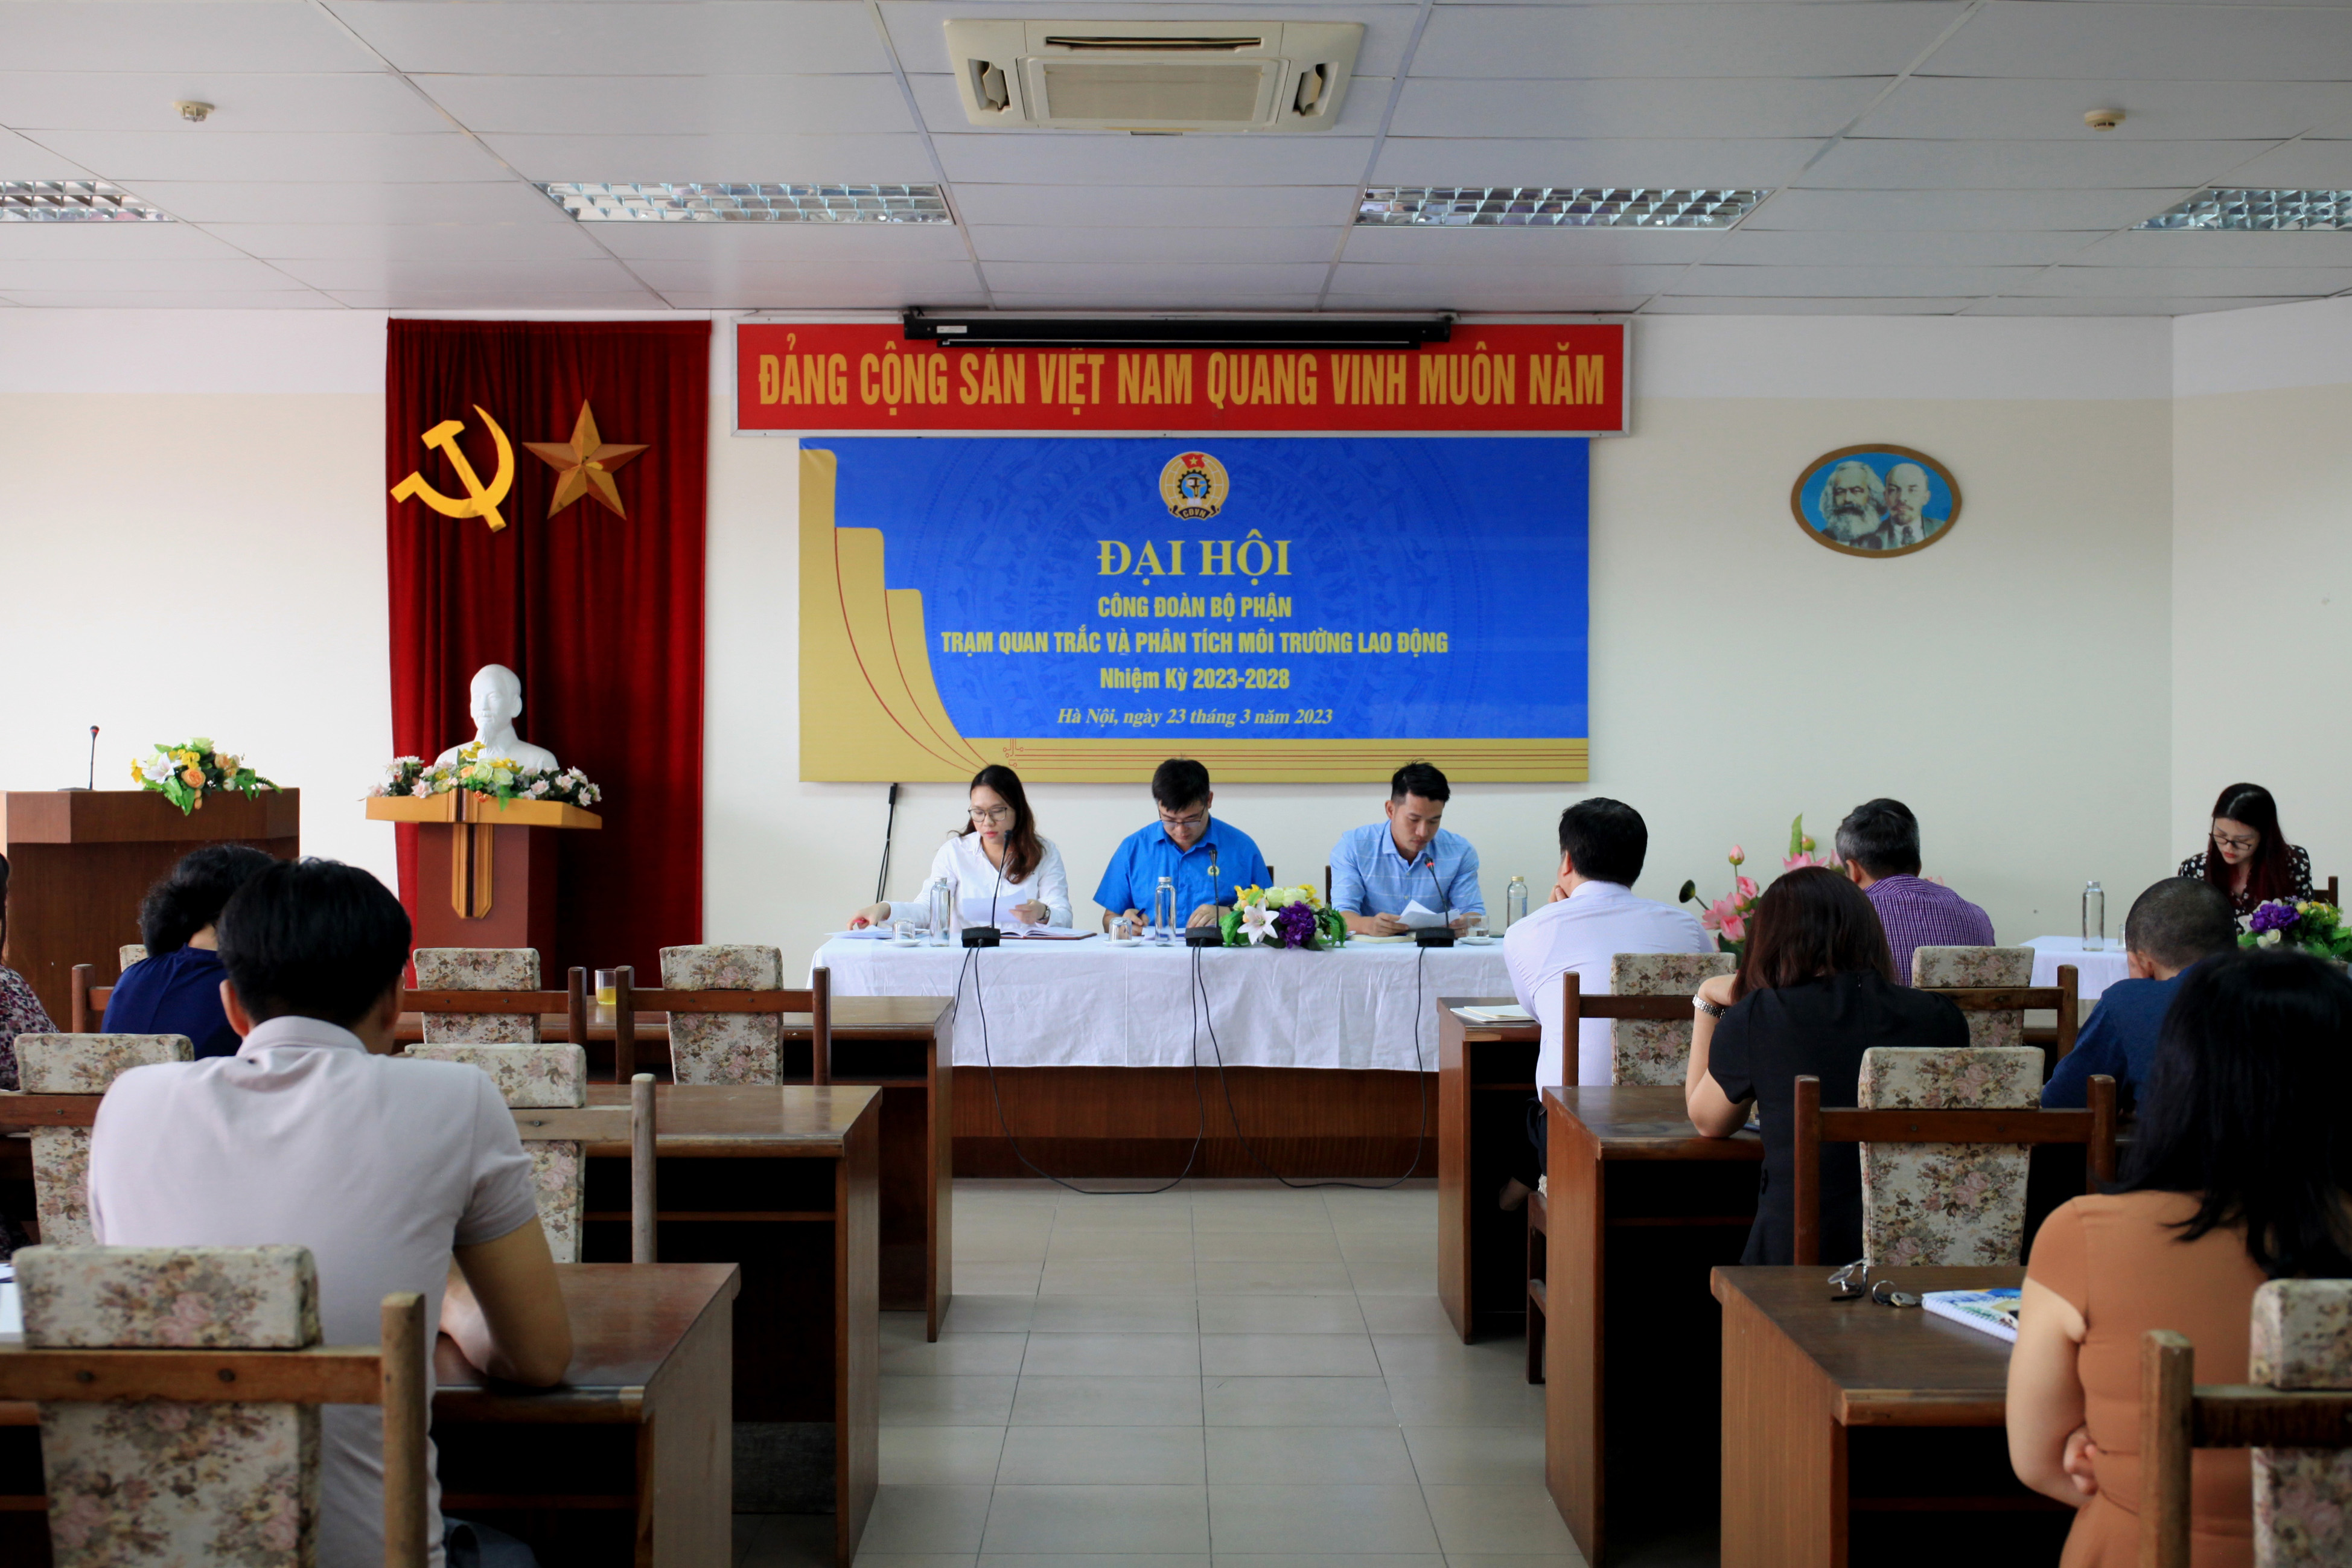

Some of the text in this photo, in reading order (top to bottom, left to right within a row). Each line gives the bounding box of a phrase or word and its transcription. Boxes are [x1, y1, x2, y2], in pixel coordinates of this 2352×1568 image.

[758, 333, 847, 406] ĐẢNG
[860, 340, 948, 416] CỘNG
[1037, 348, 1104, 415] VIỆT
[1118, 354, 1192, 404] NAM
[1207, 352, 1317, 409] QUANG
[1331, 354, 1406, 405] VINH
[1419, 341, 1515, 406] MUÔN
[1529, 342, 1604, 405] NĂM
[1097, 529, 1291, 585] ĐẠI HỘI
[1098, 592, 1292, 622] CÔNG ĐOÀN BỘ PHẬN
[942, 625, 1448, 657] TRẠM QUAN TRẮC VÀ PHÂN TÍCH MÔI TRƯỜNG LAO ĐỘNG
[1101, 668, 1290, 693] Nhiệm Kỳ 2023-2028
[1057, 708, 1333, 728] Hà Nội, ngày 23 tháng 3 năm 2023
